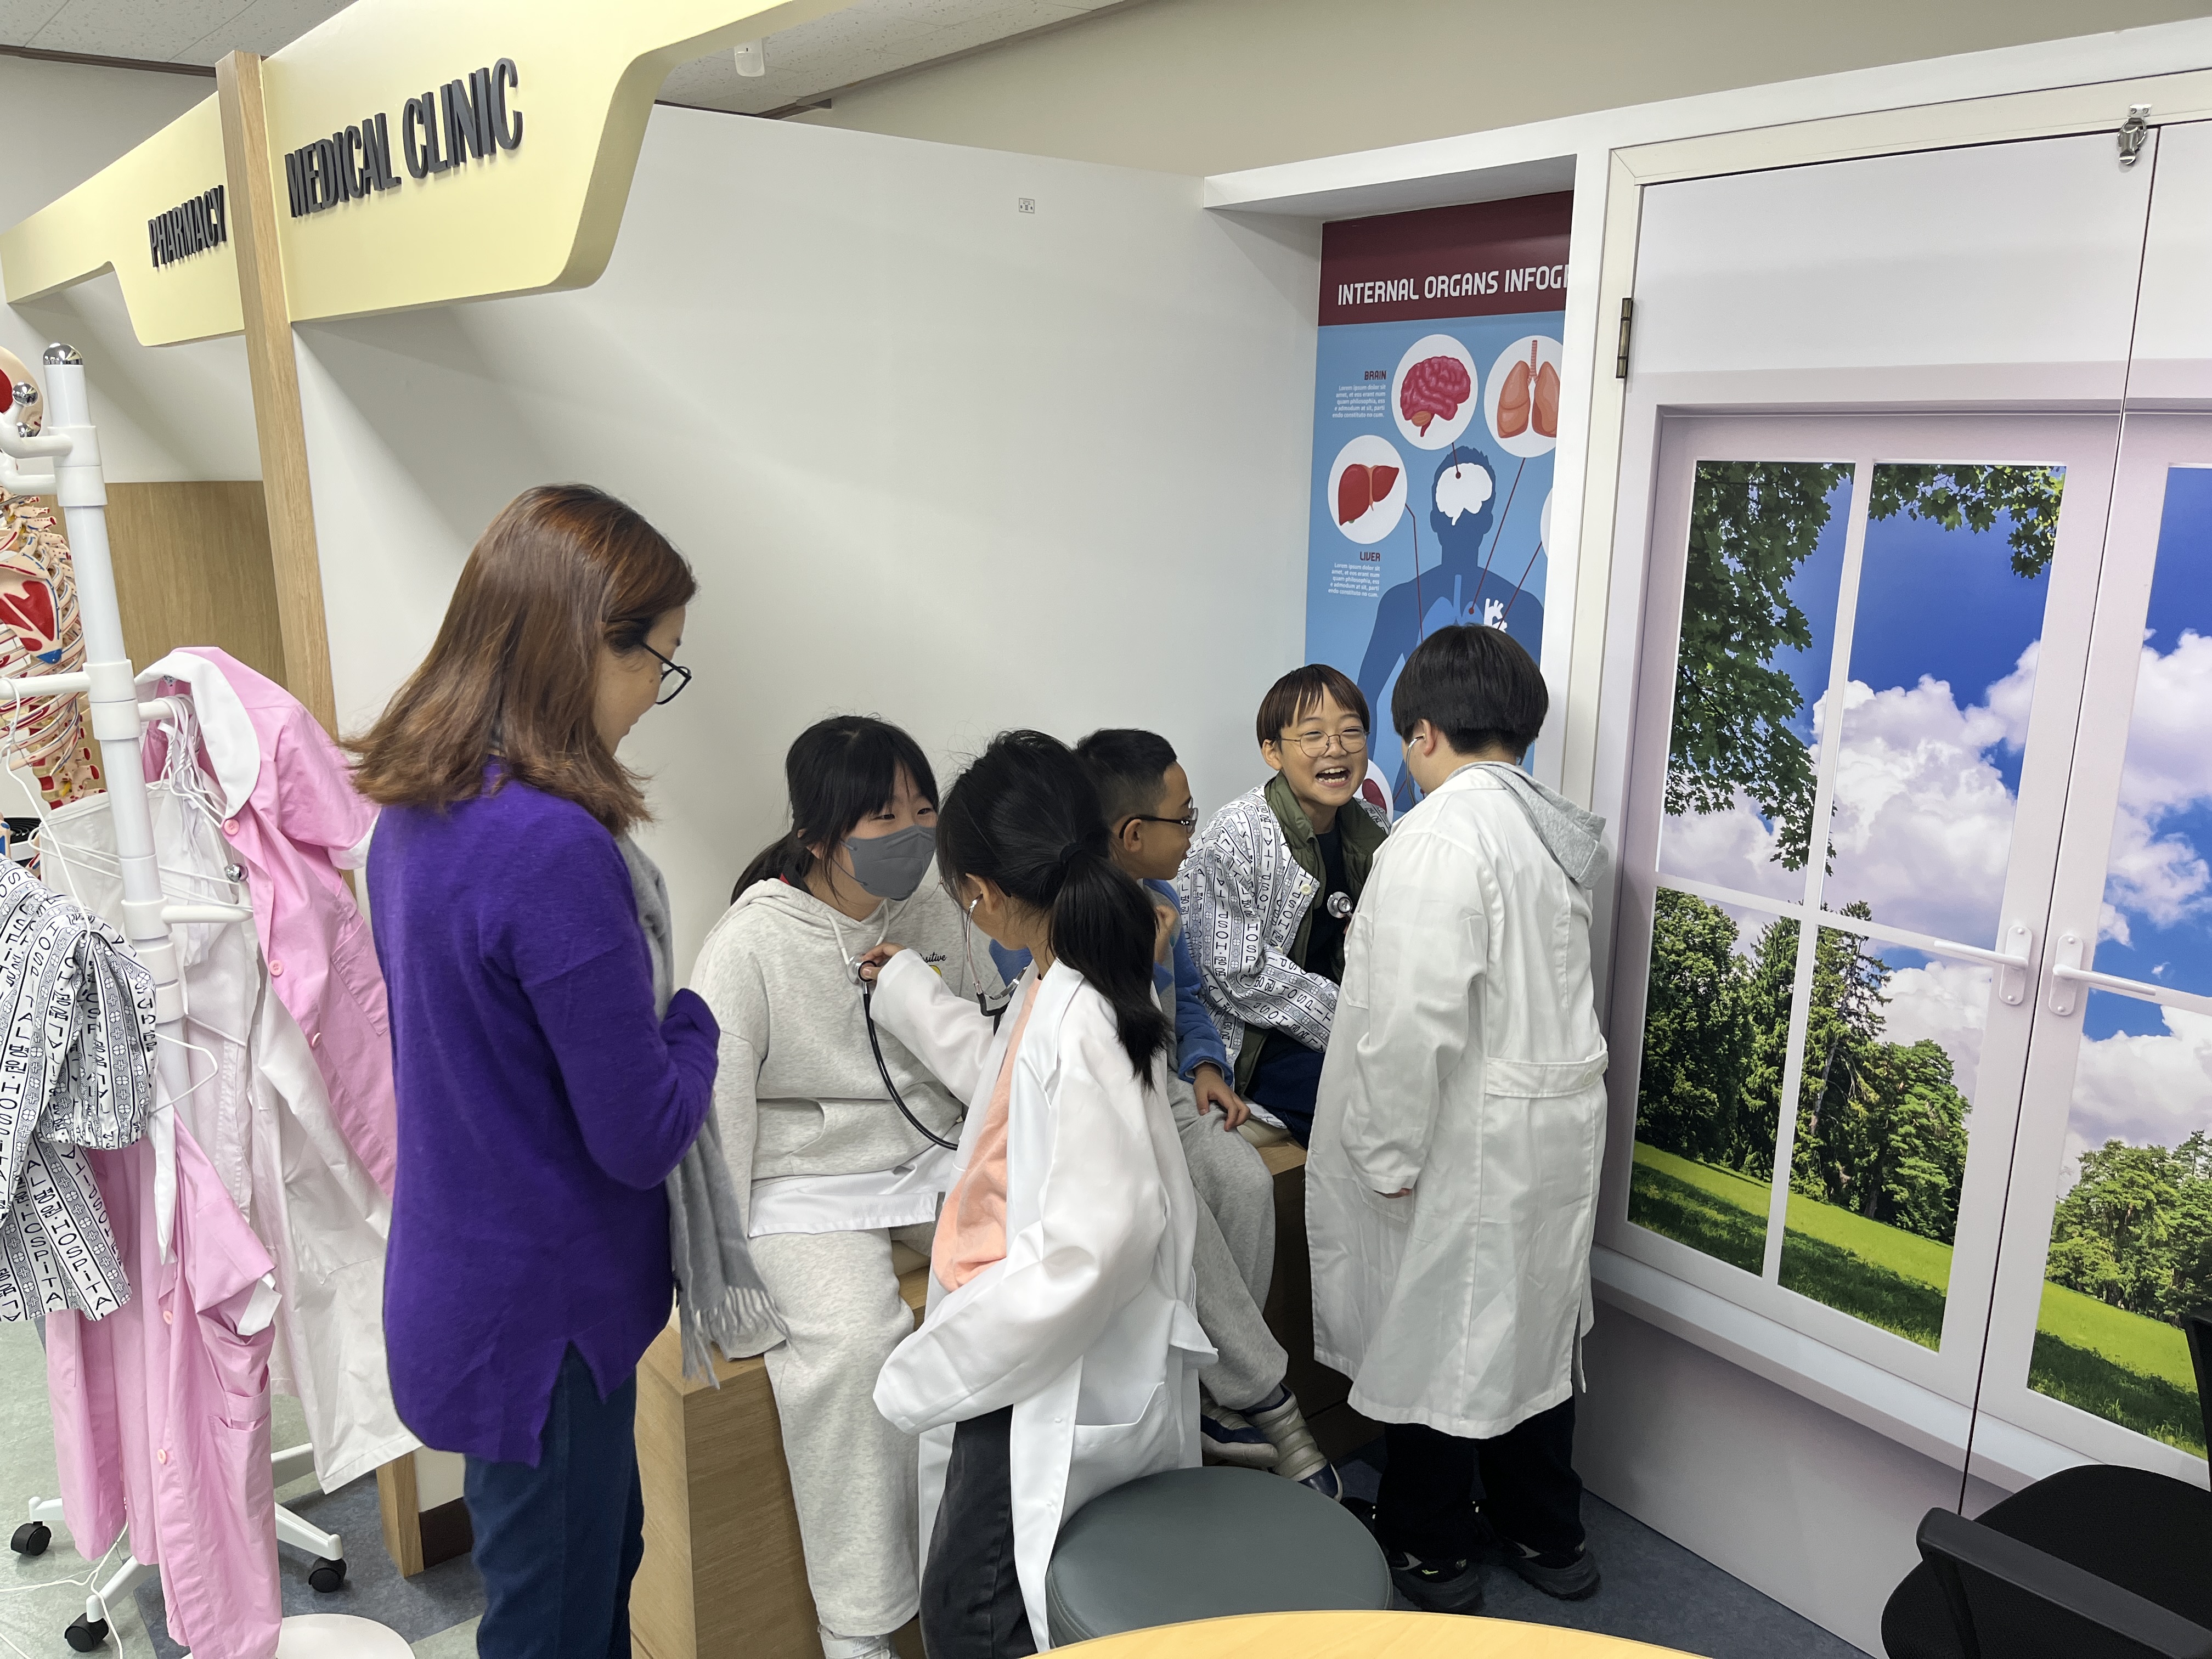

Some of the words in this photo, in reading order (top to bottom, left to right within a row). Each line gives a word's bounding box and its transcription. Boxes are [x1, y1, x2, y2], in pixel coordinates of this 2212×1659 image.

[285, 112, 402, 218] MEDICAL
[403, 58, 523, 179] CLINIC
[148, 185, 227, 267] PHARMACY
[1338, 278, 1419, 306] INTERNAL
[1424, 270, 1499, 299] ORGANS
[1364, 370, 1386, 380] BRAIN
[1360, 551, 1380, 562] LIVER
